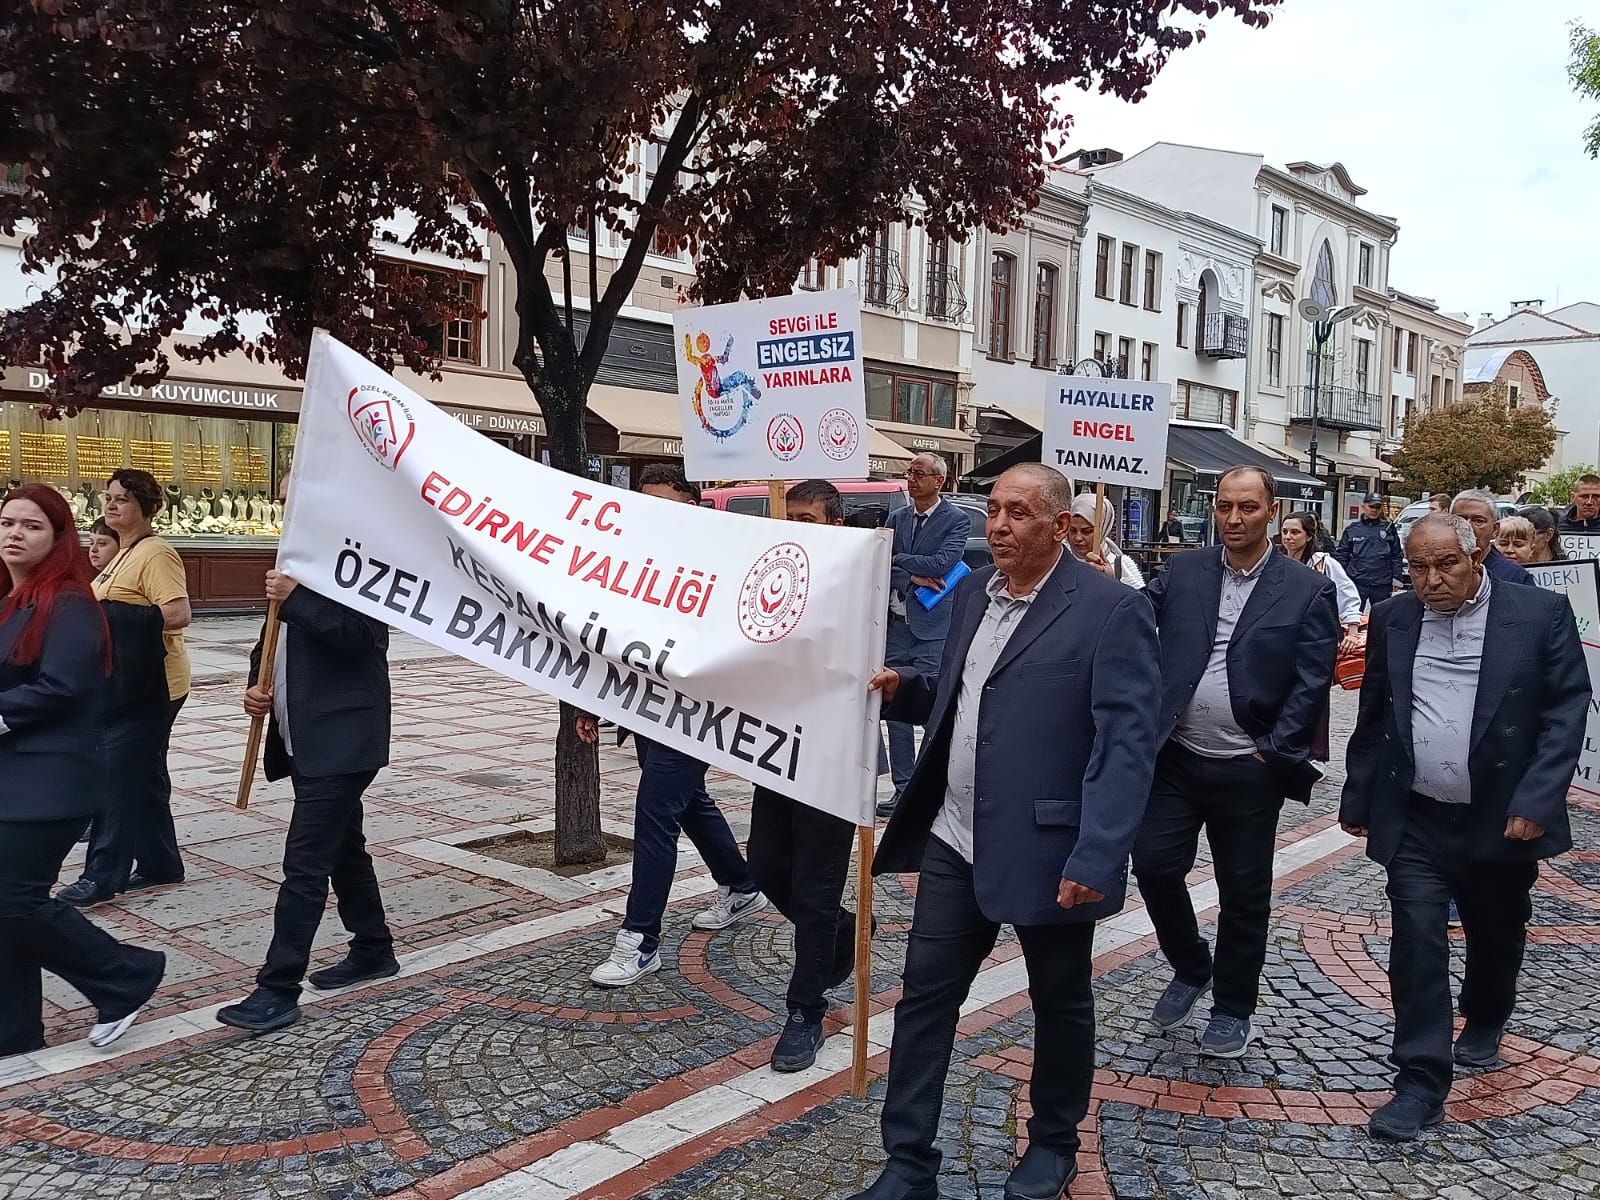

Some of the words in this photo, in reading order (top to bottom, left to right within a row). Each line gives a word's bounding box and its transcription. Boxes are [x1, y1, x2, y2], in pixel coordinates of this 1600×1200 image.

[763, 366, 852, 389] YARINLARA
[151, 384, 278, 408] KUYUMCULUK
[1059, 388, 1154, 412] HAYALLER
[489, 415, 540, 433] DÜNYASI
[1072, 420, 1135, 442] ENGEL
[868, 460, 888, 470] ERAT
[1055, 448, 1149, 475] TANIMAZ.
[565, 490, 623, 536] T.C.
[420, 471, 564, 565] EDİRNE
[567, 546, 718, 618] VALİLİĞİ
[1564, 536, 1595, 549] GEL
[447, 536, 570, 642] KEŞAN
[579, 611, 676, 682] İLGİ
[334, 537, 434, 626] ÖZEL
[445, 594, 591, 690] BAKIM
[597, 660, 803, 782] MERKEZİ
